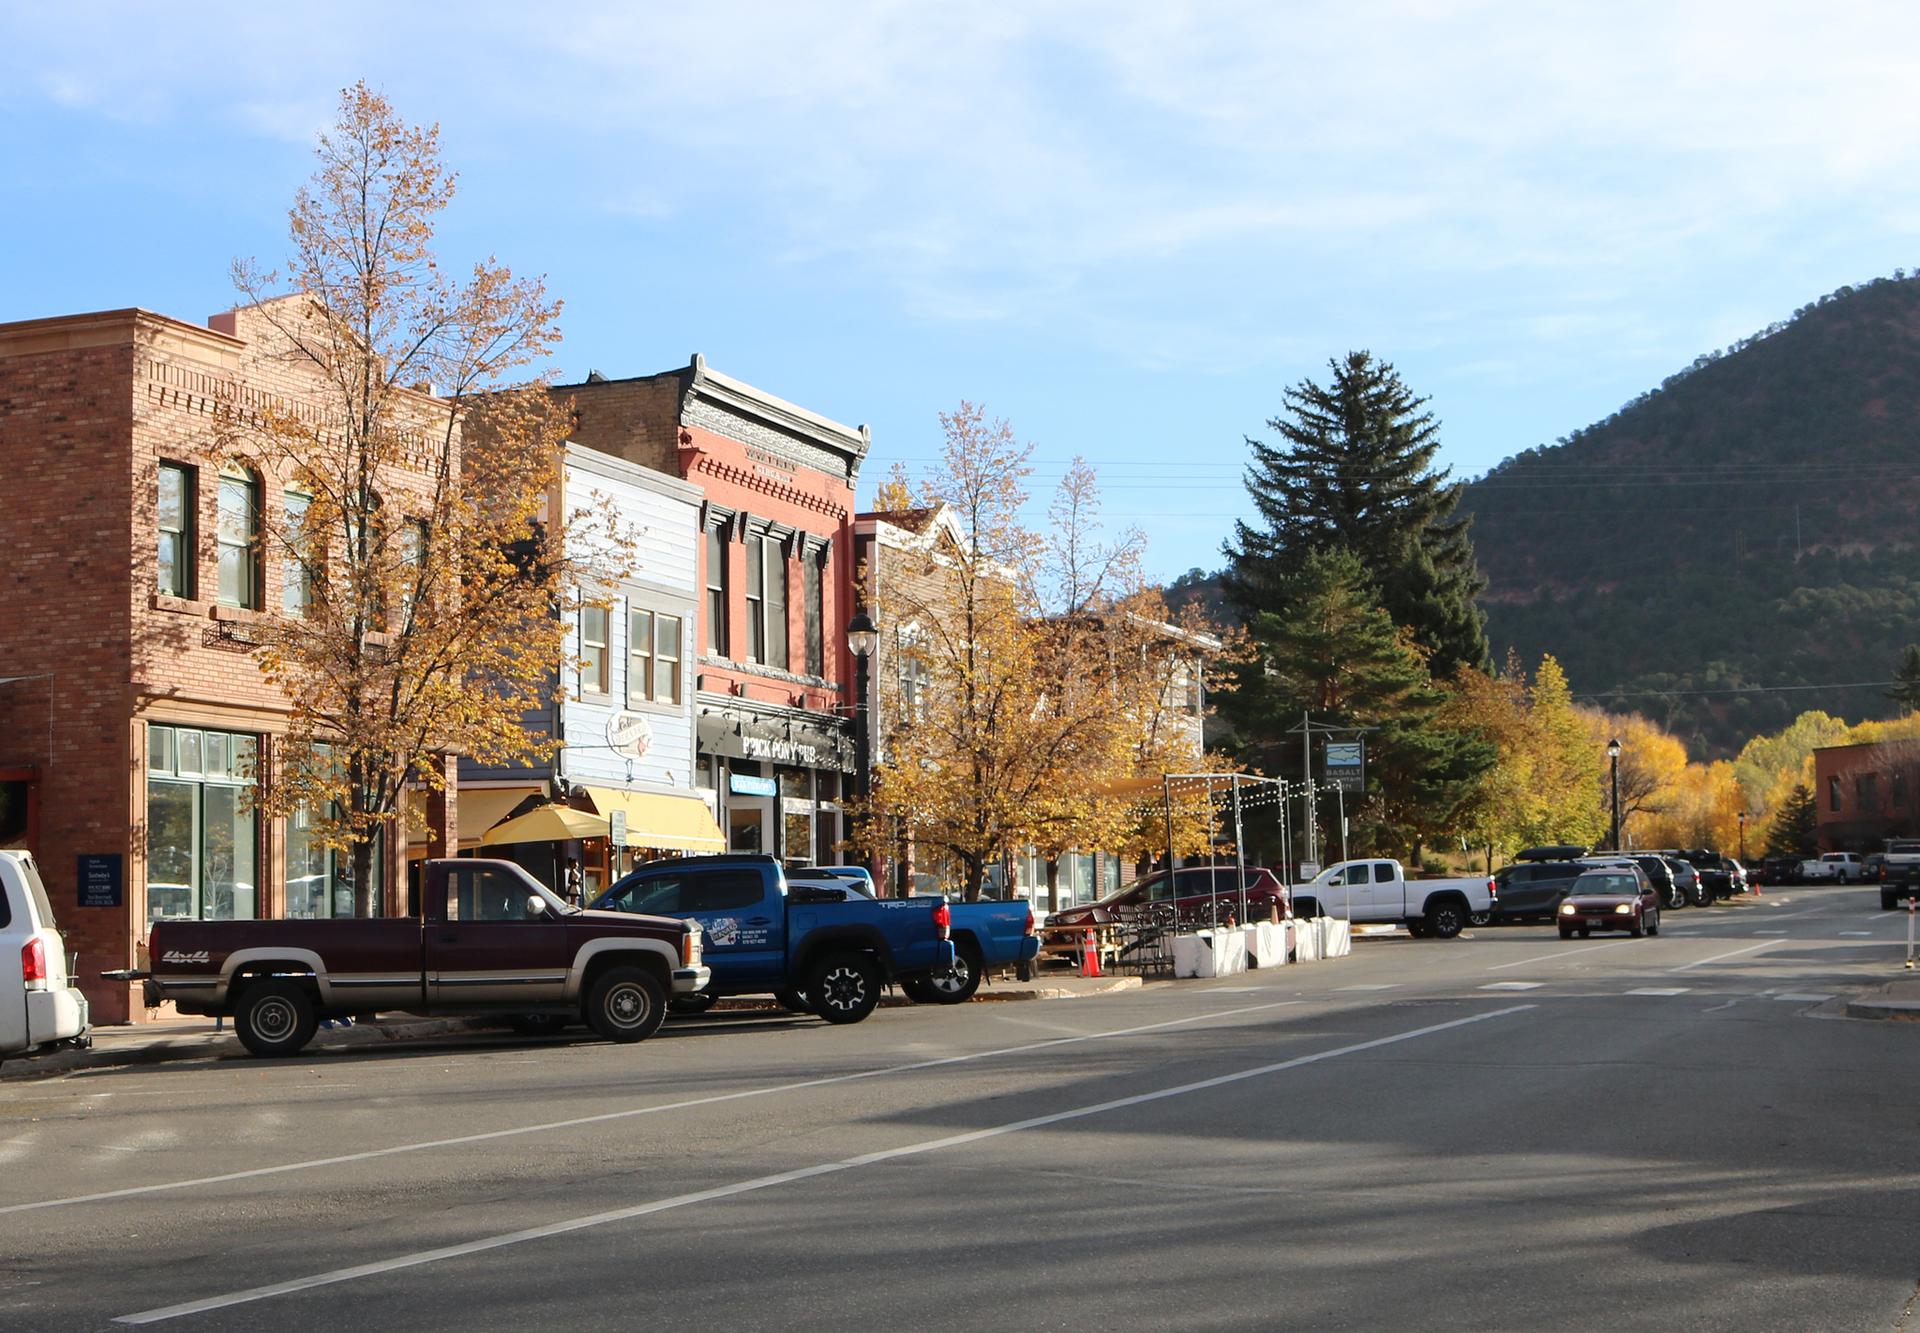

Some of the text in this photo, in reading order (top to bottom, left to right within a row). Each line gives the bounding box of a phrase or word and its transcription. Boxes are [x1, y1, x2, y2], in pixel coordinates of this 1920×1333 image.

[742, 736, 816, 763] BRICK PONY PUB
[1326, 769, 1361, 777] BASALT
[878, 901, 907, 909] TRD
